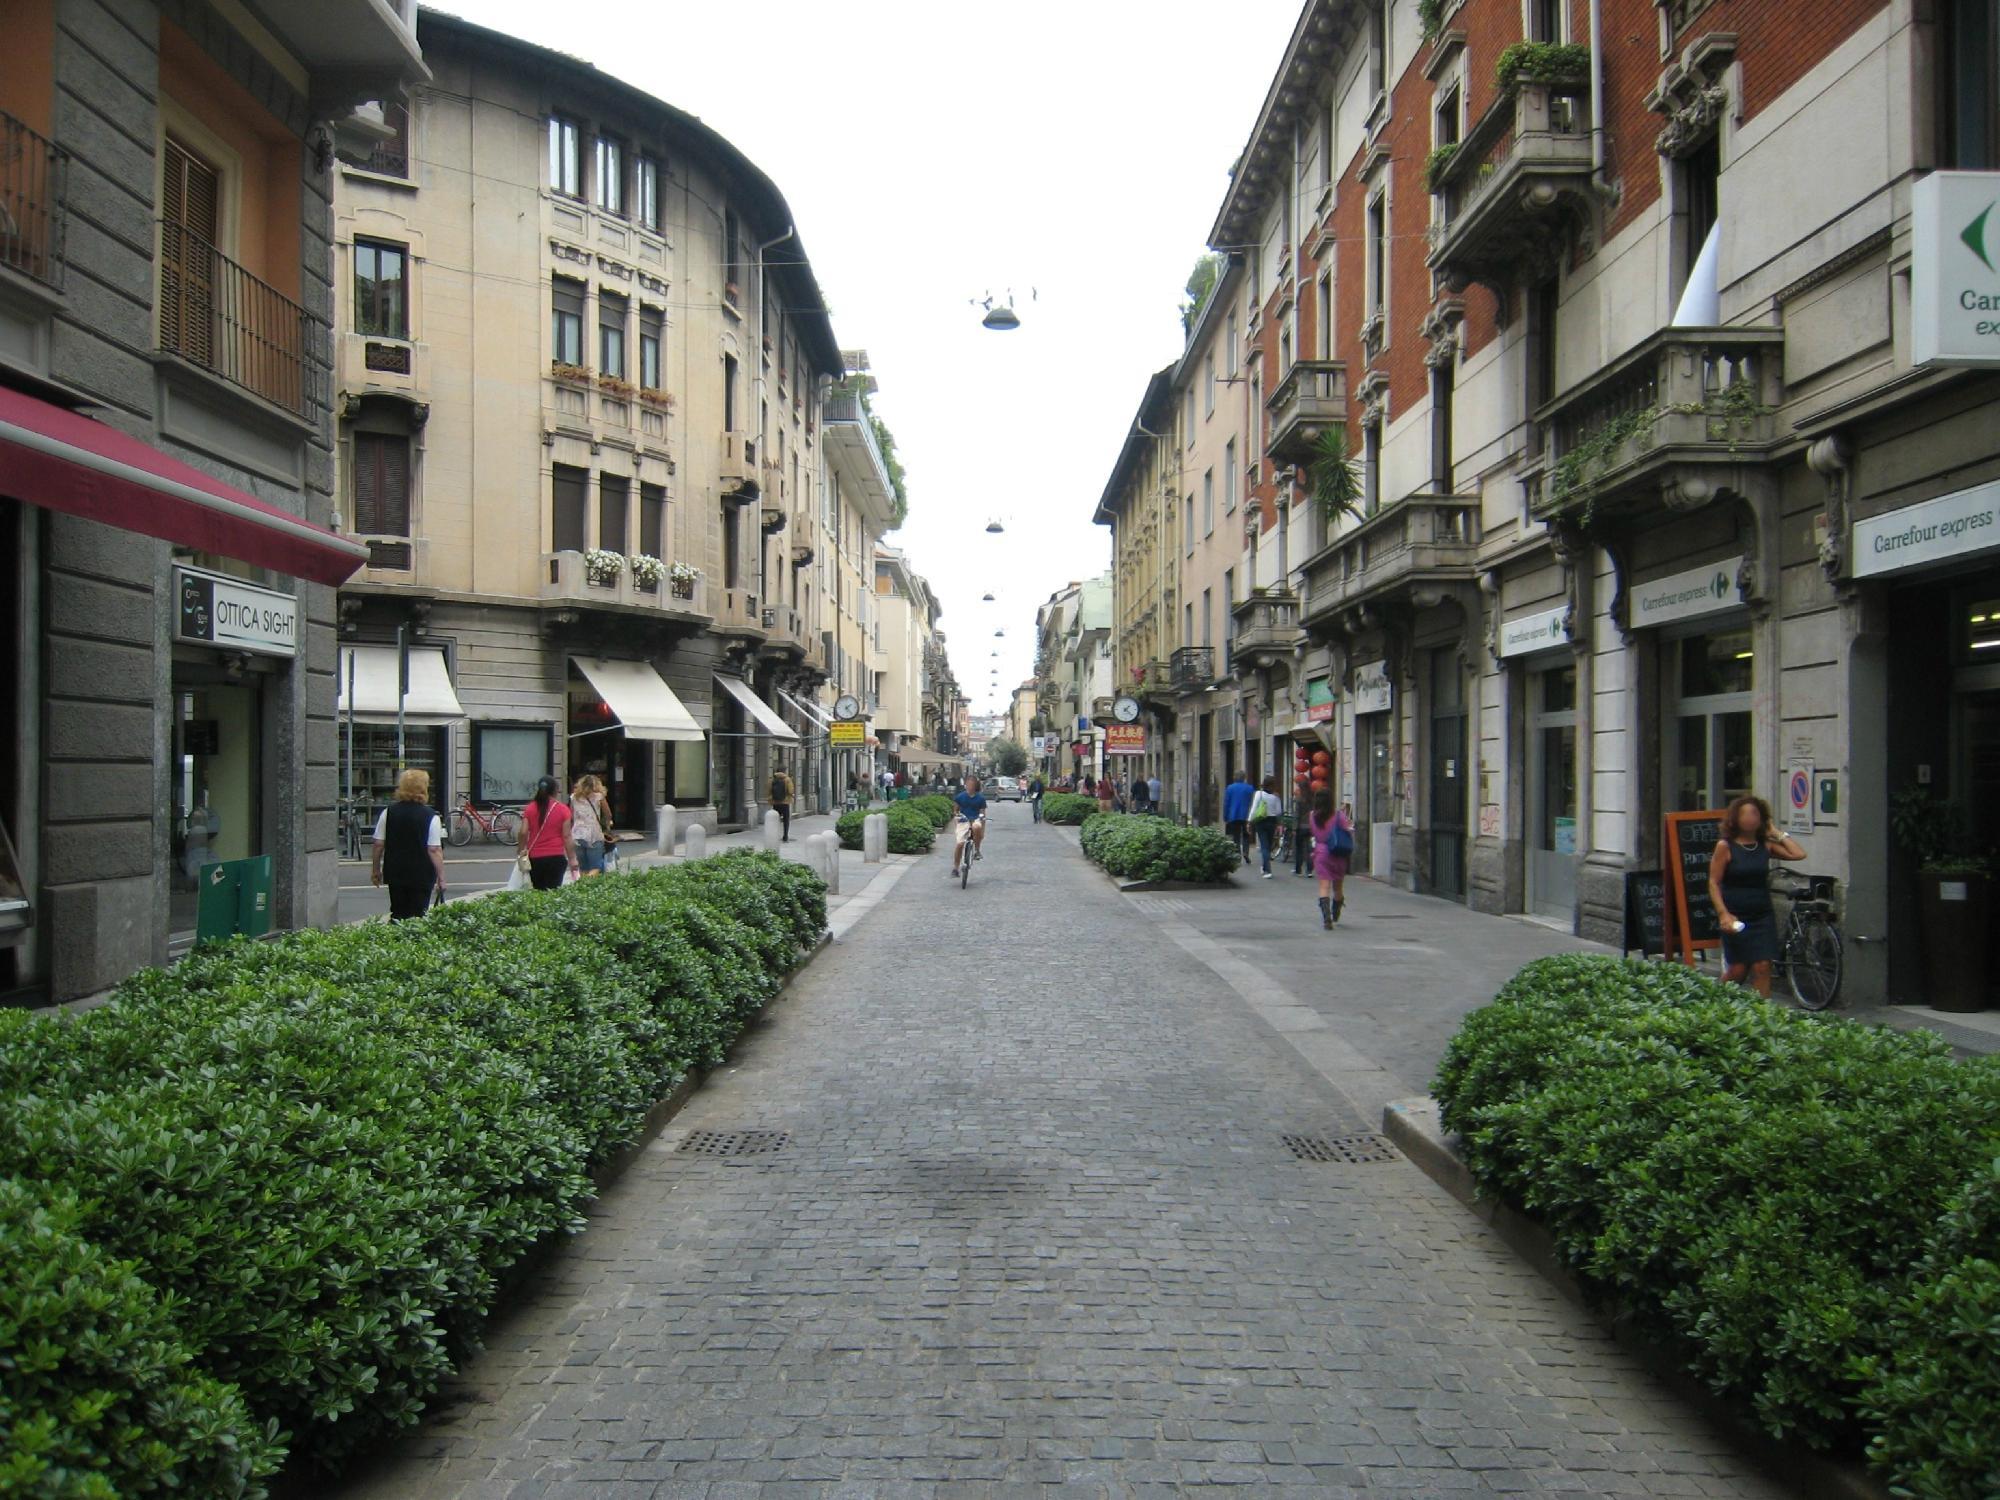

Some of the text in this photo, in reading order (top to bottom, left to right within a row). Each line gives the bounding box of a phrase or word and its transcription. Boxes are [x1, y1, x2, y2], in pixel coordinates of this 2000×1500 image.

[1874, 510, 1993, 553] Carrefour express
[1642, 586, 1708, 612] Carrefour express
[216, 600, 260, 629] OTTICA
[263, 610, 295, 636] SIGHT
